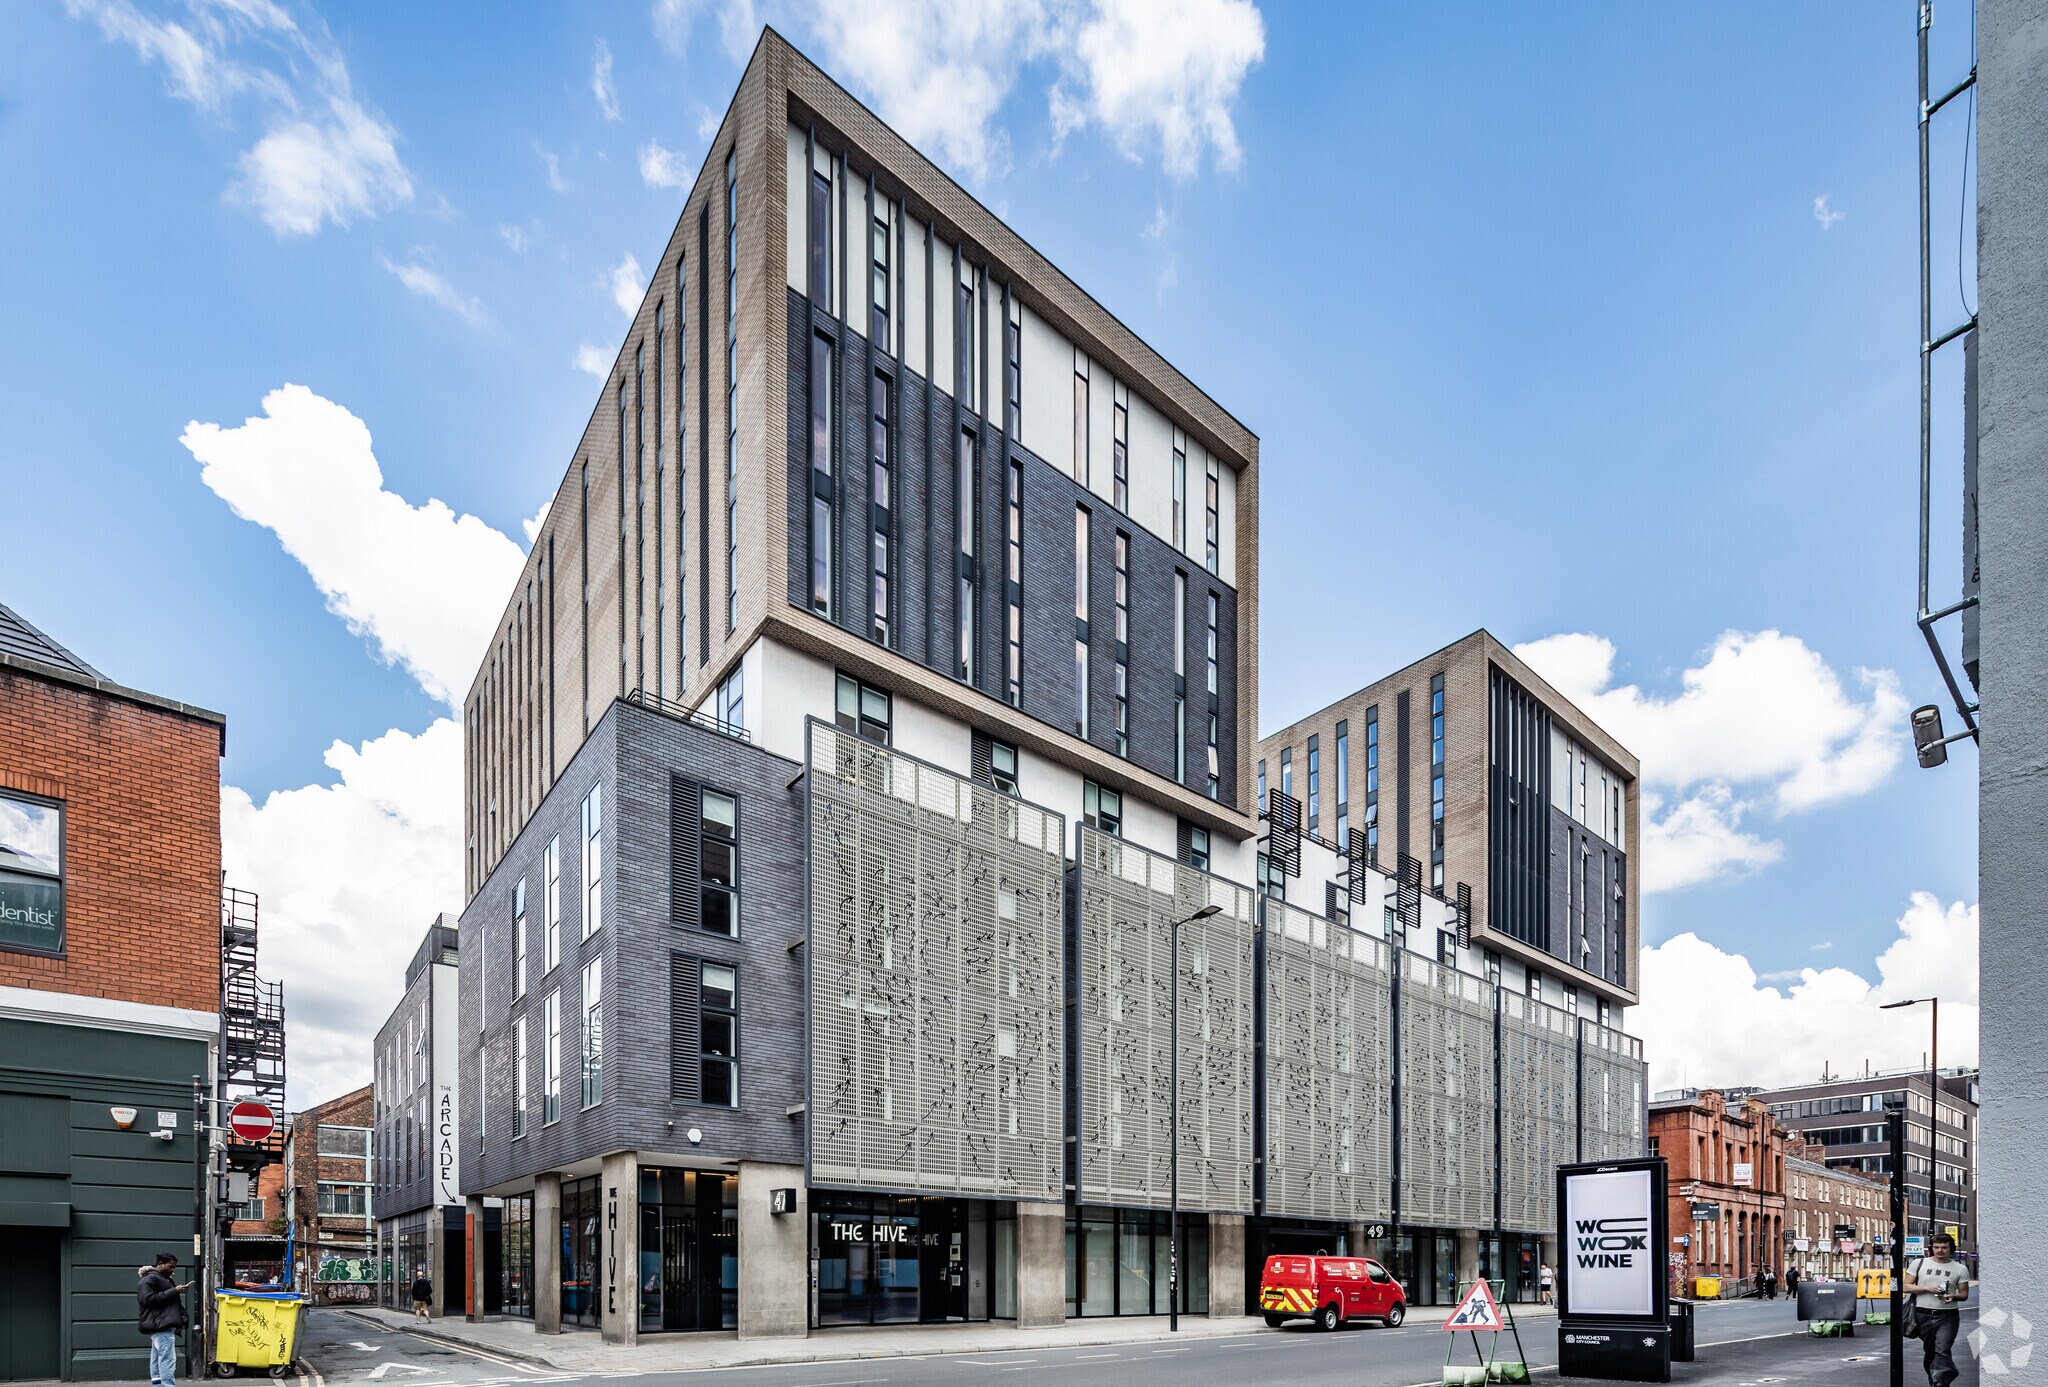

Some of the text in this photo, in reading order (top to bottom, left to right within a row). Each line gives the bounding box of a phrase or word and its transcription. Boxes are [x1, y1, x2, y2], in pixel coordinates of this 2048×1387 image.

[0, 901, 55, 926] dentist
[440, 1094, 452, 1180] ARCADE
[774, 1191, 786, 1211] 47
[831, 1223, 908, 1242] THE HIVE
[1367, 1225, 1384, 1238] 49
[608, 1201, 617, 1314] HIVE
[1576, 1254, 1632, 1268] WINE
